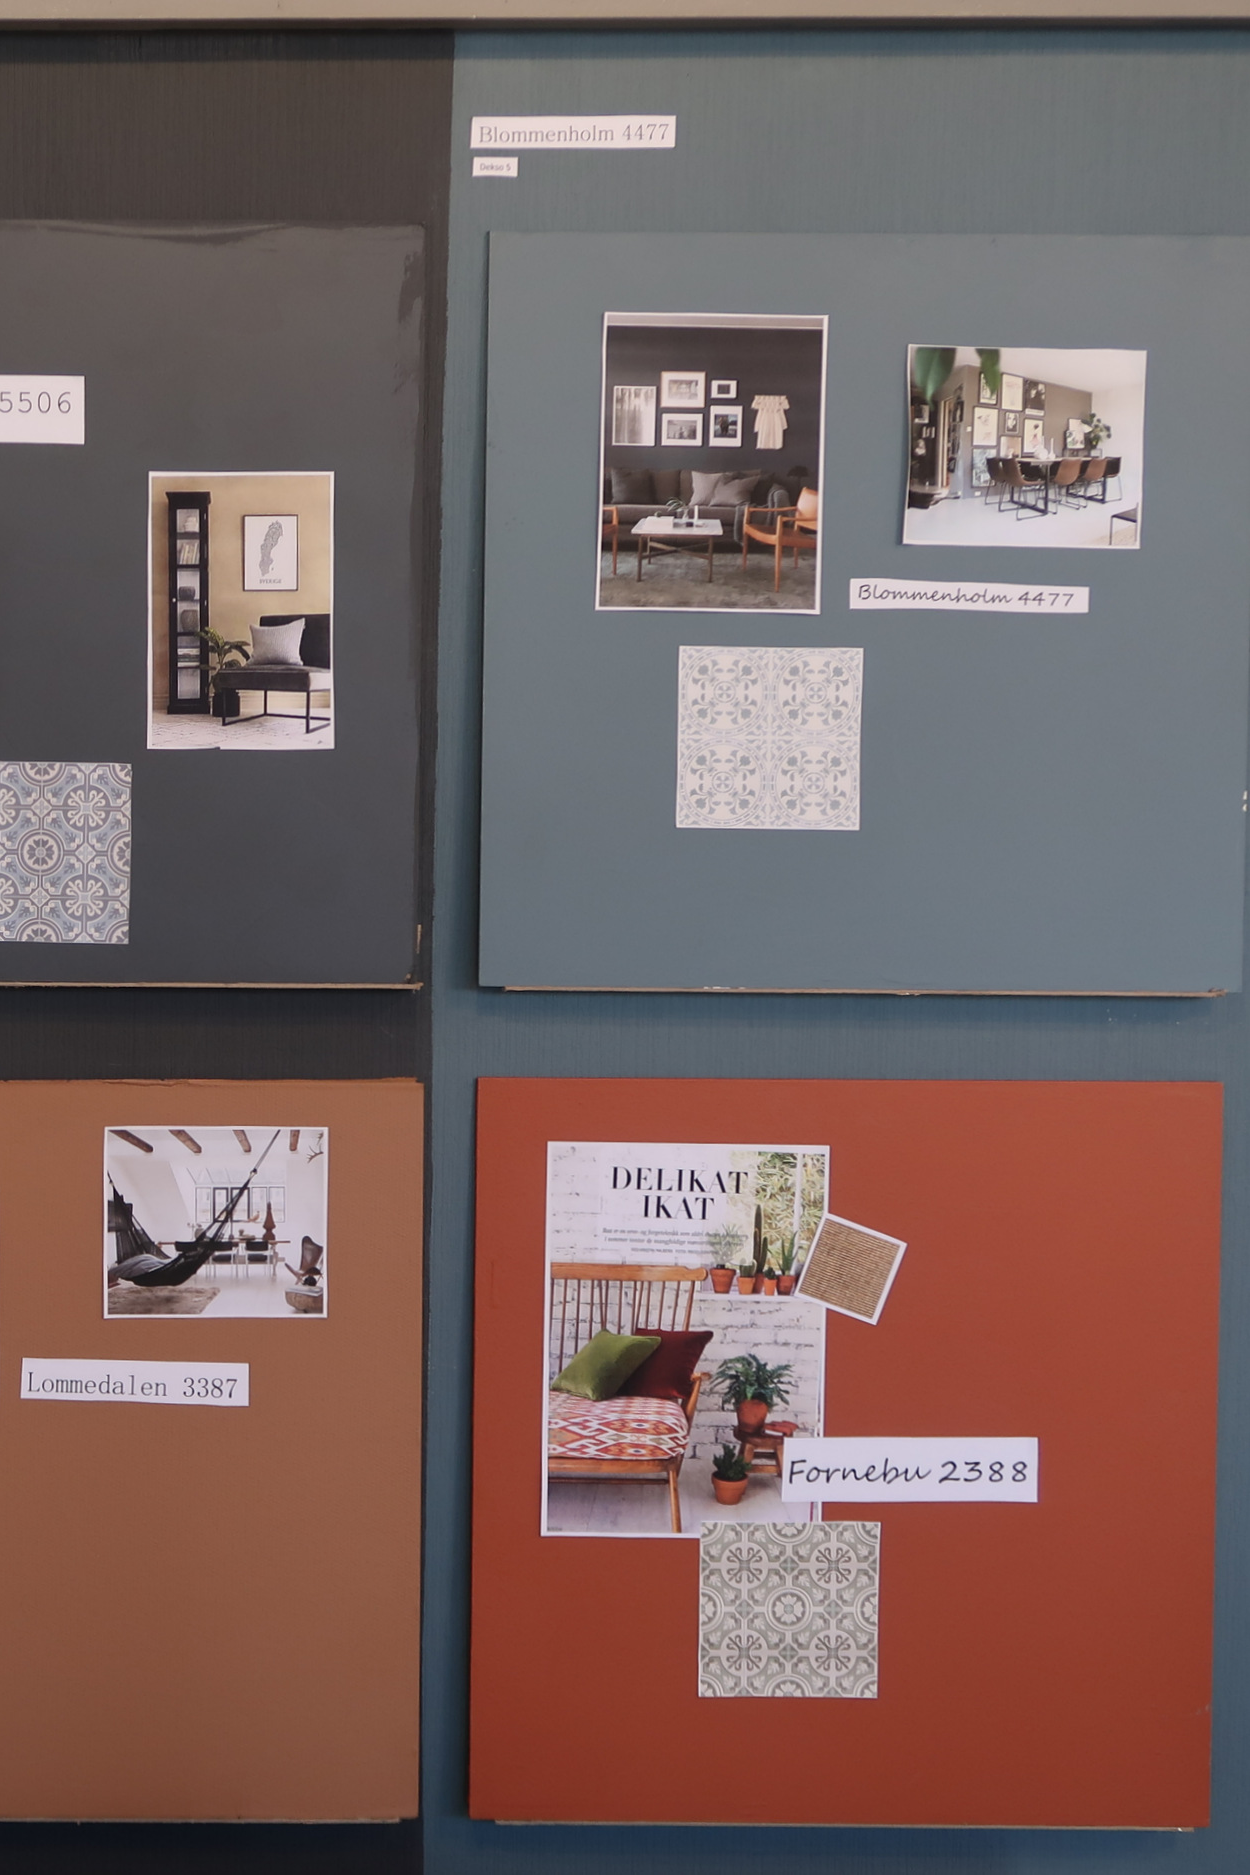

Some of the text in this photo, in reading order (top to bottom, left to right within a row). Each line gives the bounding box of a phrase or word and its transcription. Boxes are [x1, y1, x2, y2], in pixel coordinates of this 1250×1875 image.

[479, 123, 669, 144] Blommenholm 4477
[0, 391, 71, 414] 5506
[857, 583, 1075, 607] Blommenholm 4477
[612, 1166, 749, 1195] DELIKAT
[643, 1194, 716, 1221] IKAT
[27, 1371, 239, 1399] Lommedalen 3387
[788, 1457, 1028, 1485] Fornebu 2388
